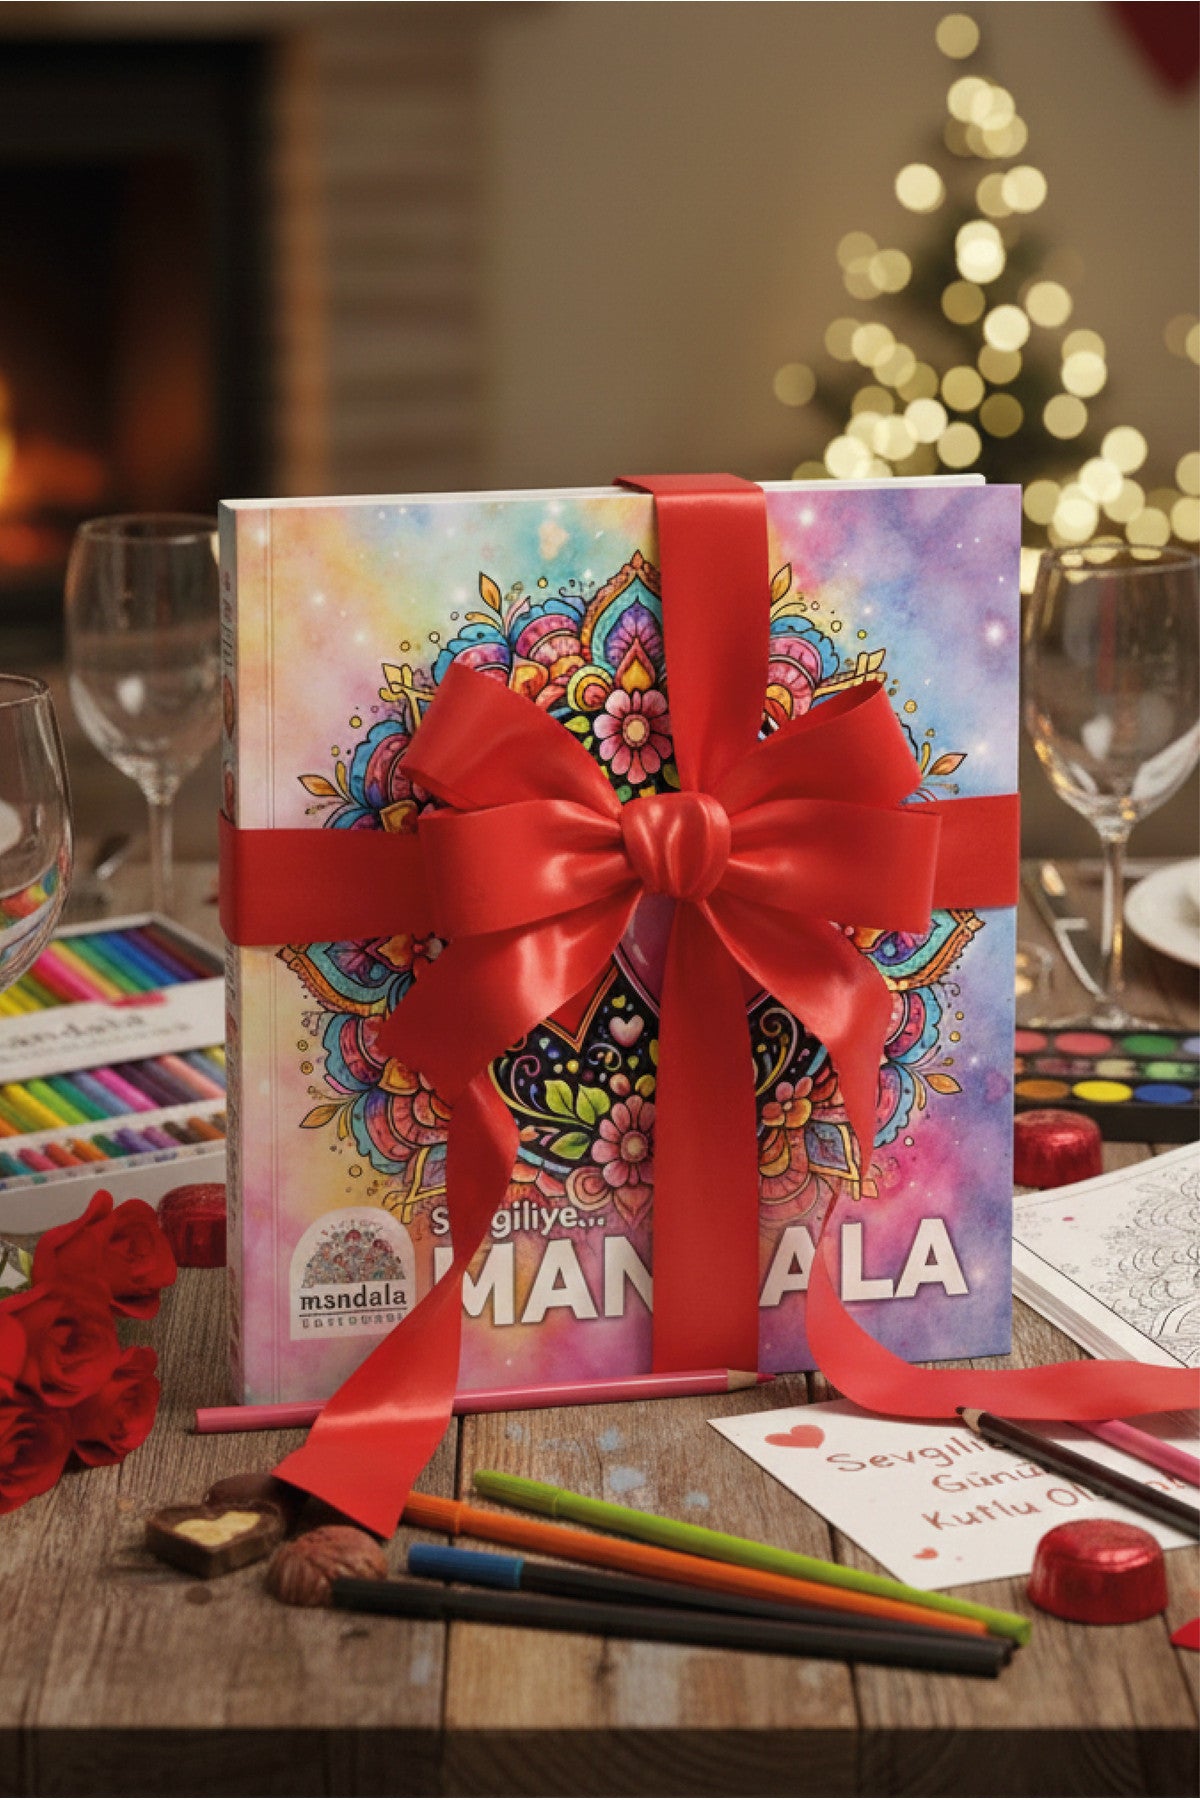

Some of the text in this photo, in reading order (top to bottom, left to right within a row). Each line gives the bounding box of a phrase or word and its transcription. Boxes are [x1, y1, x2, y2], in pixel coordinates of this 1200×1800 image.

[431, 1200, 604, 1238] Sgiliye...
[435, 1218, 969, 1326] MANALA
[931, 1462, 1046, 1493] Günü
